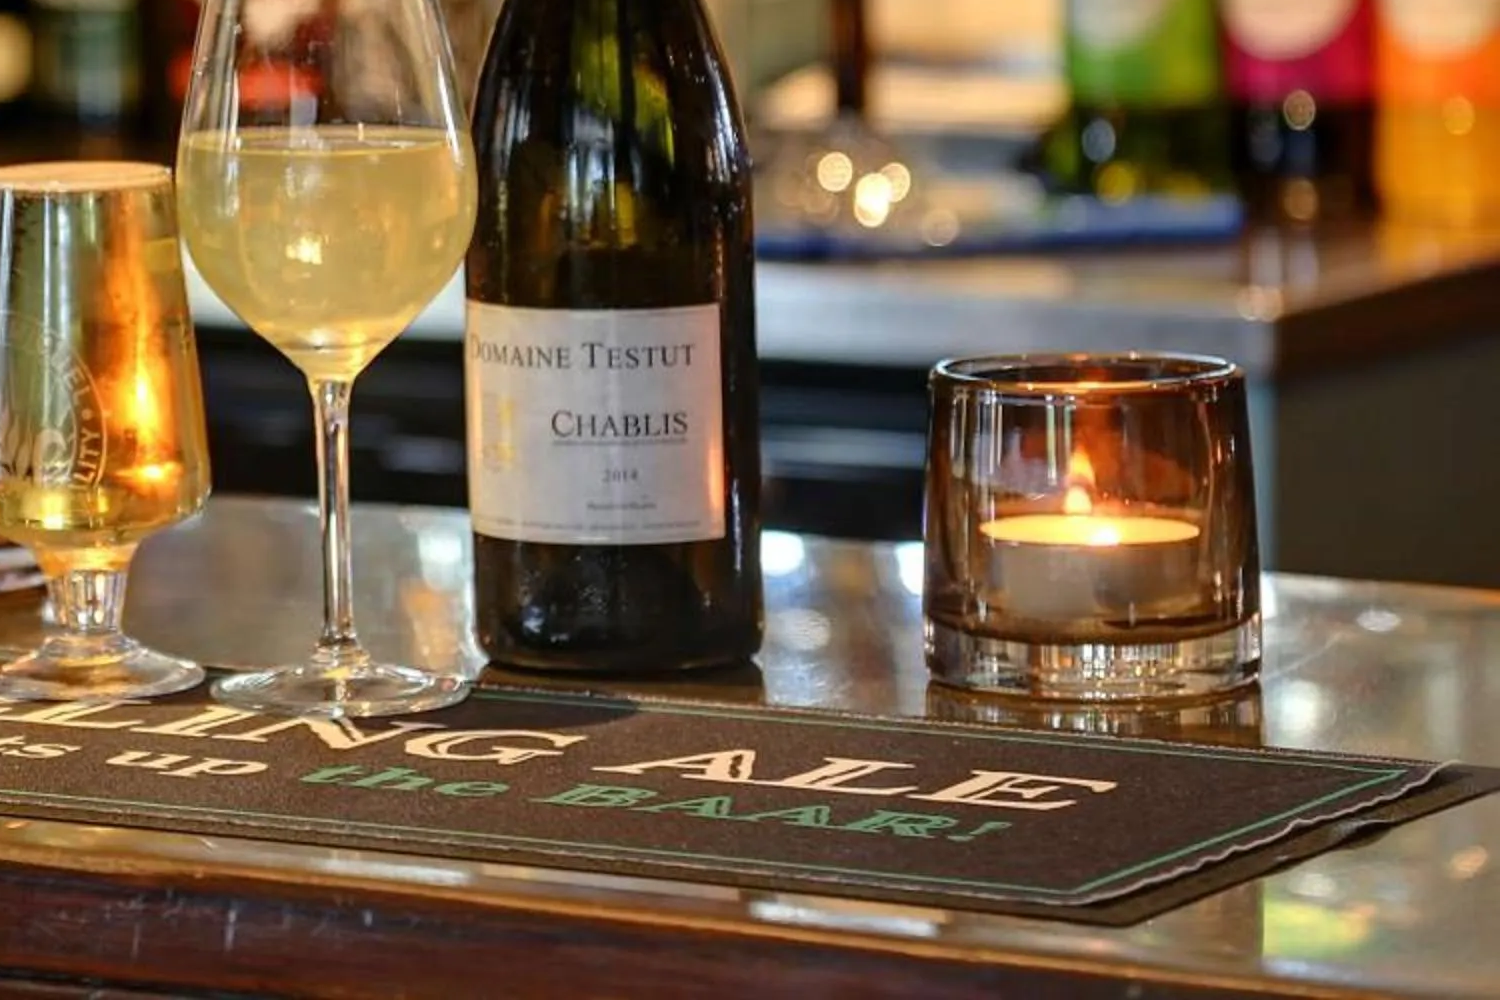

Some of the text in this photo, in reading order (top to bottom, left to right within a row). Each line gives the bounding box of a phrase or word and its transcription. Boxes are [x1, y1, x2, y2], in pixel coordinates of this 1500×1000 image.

[467, 333, 695, 370] DOMAINE TESTUT
[551, 409, 689, 438] CHABLIS
[106, 751, 269, 778] up
[300, 765, 510, 798] the
[535, 783, 1012, 843] BAAR!
[592, 749, 1117, 811] ALE
